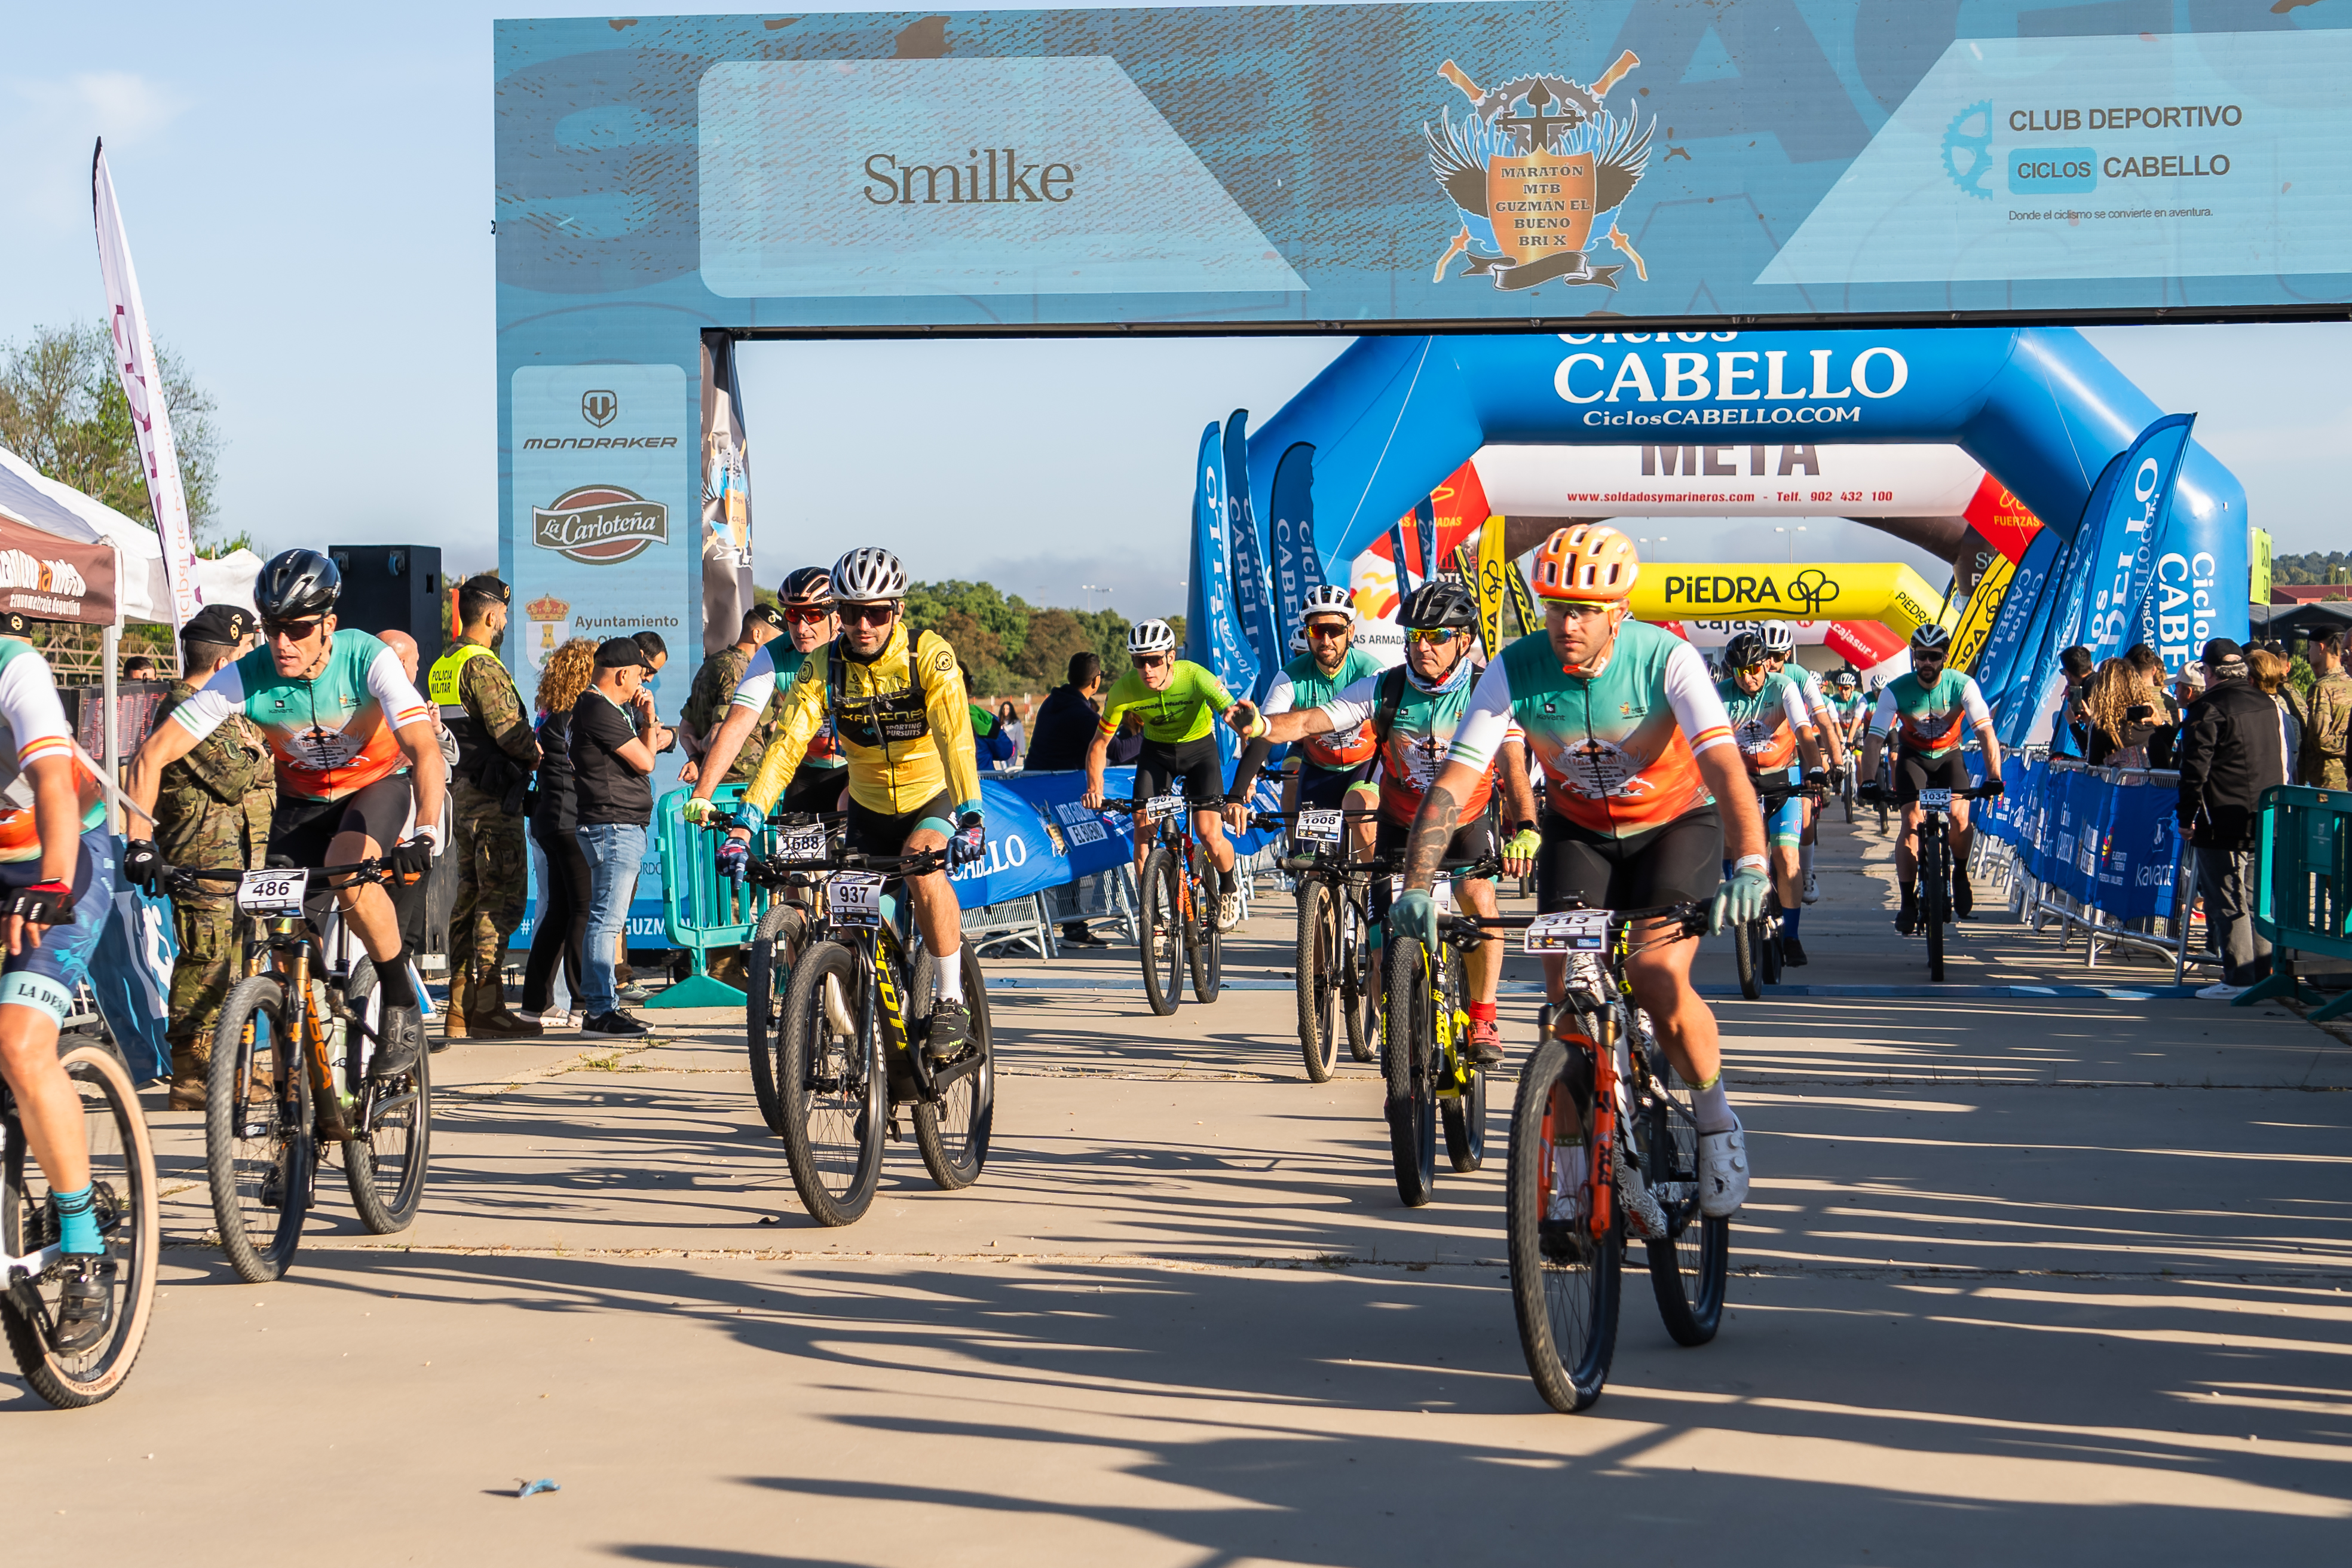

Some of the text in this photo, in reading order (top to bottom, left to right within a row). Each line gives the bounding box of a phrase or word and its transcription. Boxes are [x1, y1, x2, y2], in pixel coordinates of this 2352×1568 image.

[2009, 105, 2243, 131] CLUB DEPORTIVO
[1500, 164, 1584, 178] MARATÓN
[2017, 154, 2231, 179] CICLOS CABELLO
[863, 148, 1074, 204] Smilke
[1523, 183, 1561, 195] MTB
[1495, 198, 1591, 212] GUZMÁN EL
[2008, 210, 2042, 221] Donde
[2043, 209, 2052, 220] el
[2054, 209, 2092, 220] ciclismo
[2108, 208, 2152, 219] convierte
[2169, 207, 2213, 218] aventura.
[1514, 217, 1570, 229] BUENO
[1518, 235, 1567, 246] BRI X
[1554, 346, 1909, 405] CABELLO
[1582, 406, 1861, 427] CiclosCABELLO.COM
[523, 436, 678, 449] MONDRAKER
[1567, 490, 1755, 504] www.soldadosymarineros.com
[1777, 491, 1802, 503] Telf.
[1810, 491, 1833, 502] 902
[1840, 491, 1863, 502] 432
[1872, 490, 1893, 502] 100
[1993, 514, 2040, 527] FUERZAS
[540, 512, 658, 546] La Carloteña
[2007, 572, 2044, 642] Ciclos
[575, 615, 679, 630] Ayuntamiento
[1980, 568, 2031, 682] CABELLO
[431, 682, 451, 694] MILITAR
[1133, 703, 1162, 711] Conejo
[1303, 816, 1336, 825] 1008
[2135, 863, 2174, 887] kavant
[252, 881, 290, 896] 486
[840, 886, 869, 904] 937
[17, 983, 36, 998] LA
[286, 1067, 302, 1103] FOX
[1597, 1142, 1612, 1186] FOX
